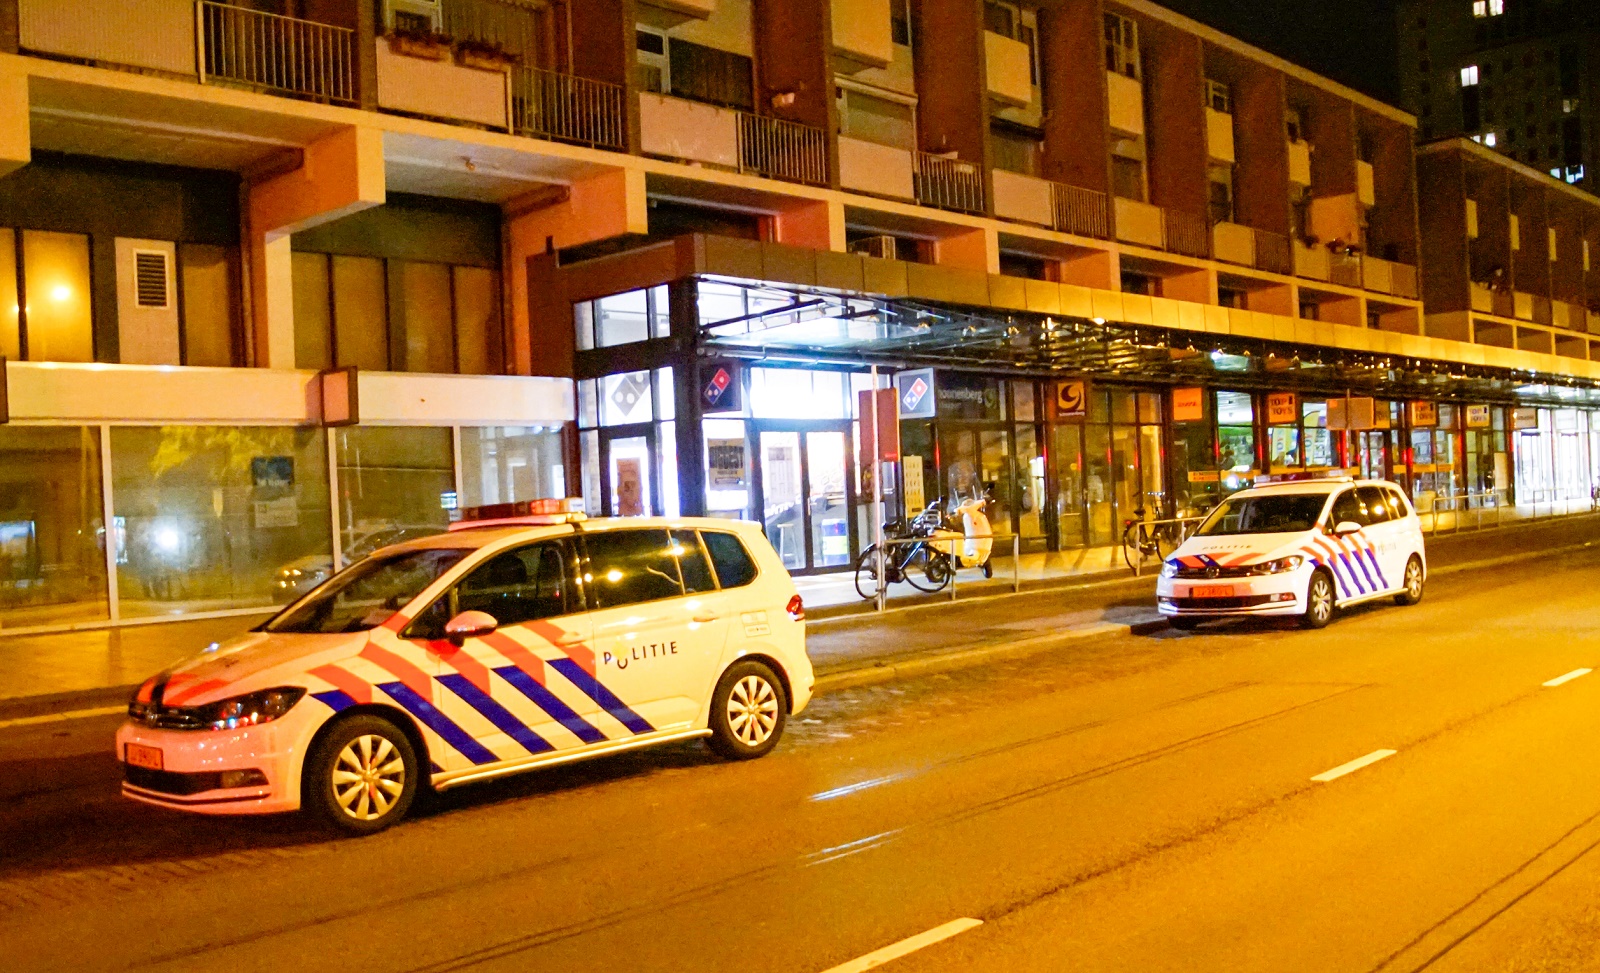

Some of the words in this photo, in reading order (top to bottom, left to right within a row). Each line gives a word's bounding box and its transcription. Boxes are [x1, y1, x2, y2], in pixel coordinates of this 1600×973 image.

[1270, 398, 1287, 406] TOP
[1273, 407, 1293, 415] TOYS
[1202, 543, 1252, 551] POLITIE
[604, 642, 678, 668] POLITIE
